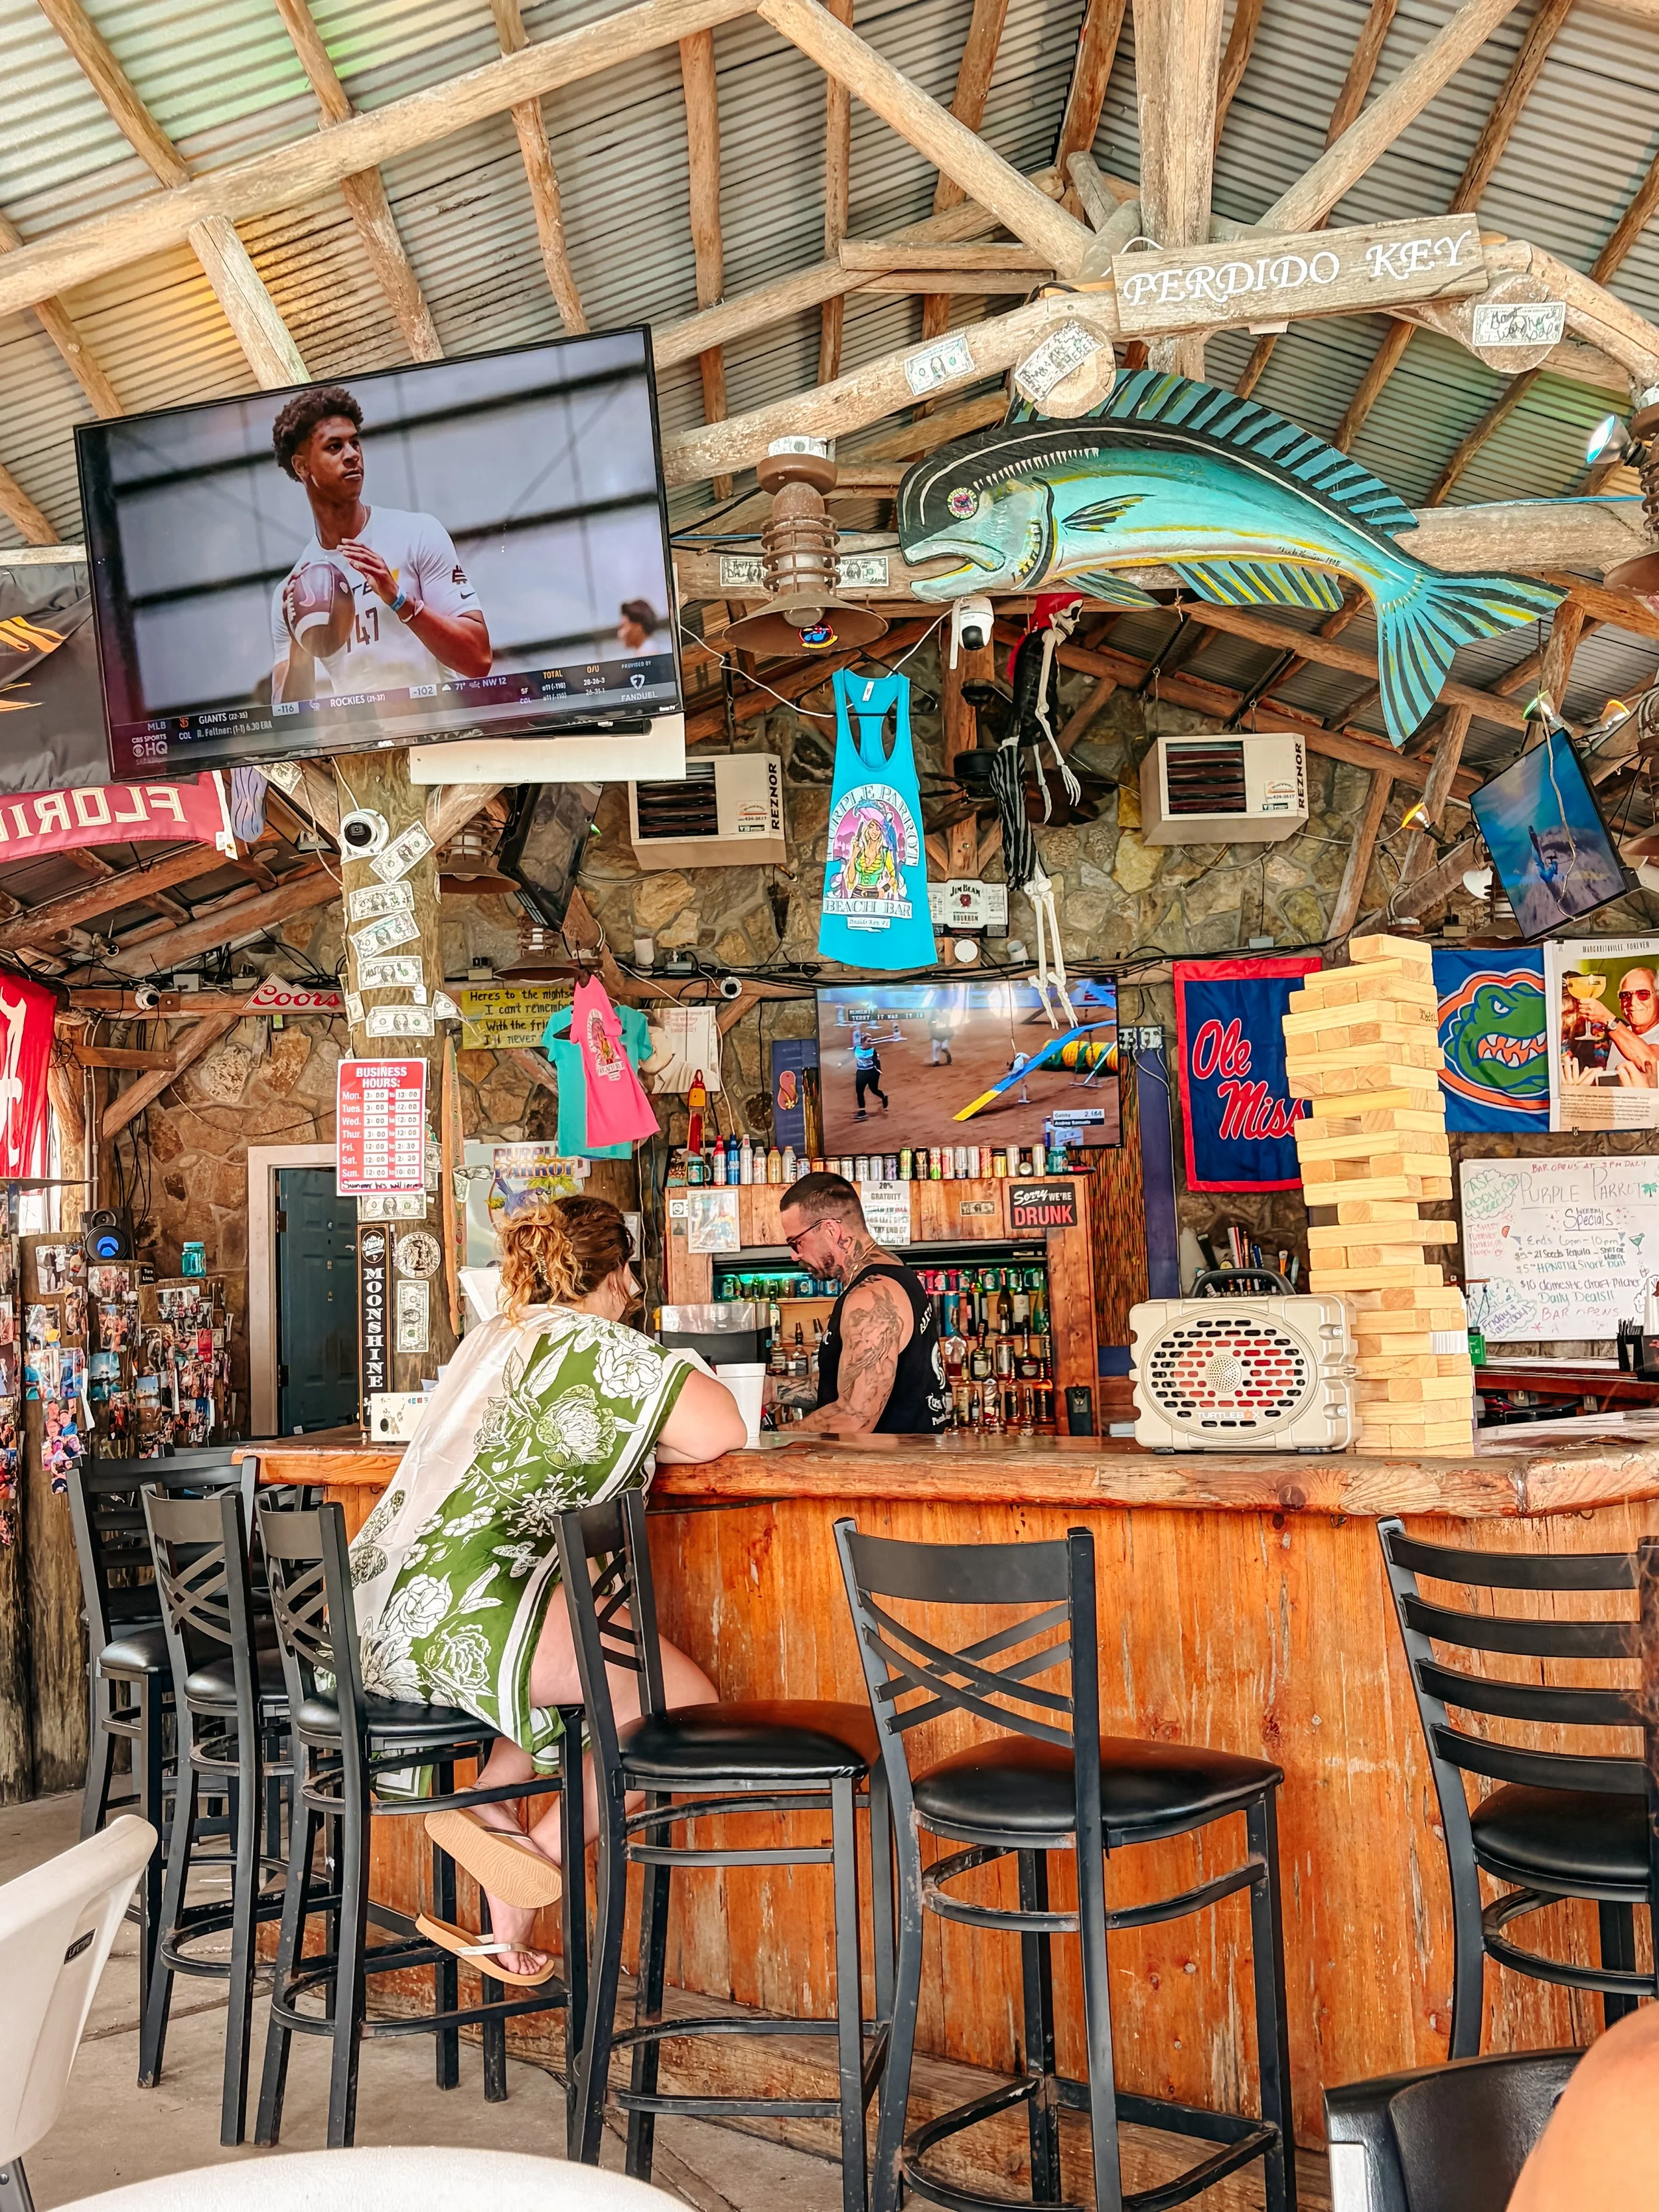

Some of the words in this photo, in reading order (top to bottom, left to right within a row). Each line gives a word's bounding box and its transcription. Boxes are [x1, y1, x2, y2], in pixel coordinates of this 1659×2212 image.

[1123, 252, 1340, 306] PERDIDO
[1365, 230, 1473, 279] KEY
[543, 670, 563, 680] TOTAL
[621, 692, 658, 702] FANDUEL
[147, 721, 166, 731] MLB
[199, 713, 227, 725] GIANTS
[330, 696, 365, 707] ROCKIES
[366, 694, 386, 703] (21-37)
[413, 687, 433, 696] -102
[179, 731, 192, 740] COL
[260, 720, 272, 730] ERA
[144, 733, 167, 742] SPORTS
[145, 741, 168, 756] HQ
[1295, 743, 1306, 810] REZNOR
[768, 763, 780, 830] REZNOR
[878, 785, 918, 865] PARROT
[950, 886, 962, 897] JIM
[963, 884, 981, 897] BEAM
[825, 900, 876, 913] BEACH
[884, 903, 911, 917] BAR
[1627, 941, 1650, 950] FOREVER
[252, 985, 340, 1006] Coors
[470, 992, 500, 1001] Here's
[505, 990, 516, 999] to
[522, 990, 540, 999] the
[485, 1005, 493, 1015] I
[498, 1002, 521, 1014] can't
[486, 1020, 508, 1031] With
[510, 1019, 526, 1029] the
[507, 1035, 537, 1044] never
[1192, 1017, 1252, 1080] Ole
[356, 1067, 407, 1078] BUSINESS
[362, 1077, 401, 1088] HOURS:
[342, 1091, 362, 1100] Mon.
[342, 1104, 363, 1113] Tues.
[1217, 1079, 1305, 1141] Miss
[342, 1117, 362, 1126] Wed.
[342, 1130, 362, 1139] Thur.
[342, 1143, 355, 1152] Fri.
[494, 1146, 559, 1161] PURPL
[342, 1155, 358, 1165] Sat.
[342, 1169, 360, 1178] Sun.
[494, 1161, 575, 1179] PARROT
[1532, 1163, 1550, 1173] BAR
[1520, 1171, 1579, 1205] PURPLE
[1593, 1167, 1645, 1201] PARROT
[1014, 1189, 1048, 1205] Sorry
[1048, 1192, 1072, 1201] WE'RE
[1014, 1205, 1073, 1226] DRUNK
[1563, 1209, 1614, 1230] Specials
[1566, 1248, 1591, 1258] Tequila
[1520, 1280, 1536, 1290] $10
[1539, 1279, 1583, 1291] domestic
[1538, 1291, 1570, 1307] Daily
[1542, 1307, 1569, 1321] BAR
[363, 1267, 385, 1388] MOONSHINE
[1196, 1410, 1261, 1420] TURTLEBOX
